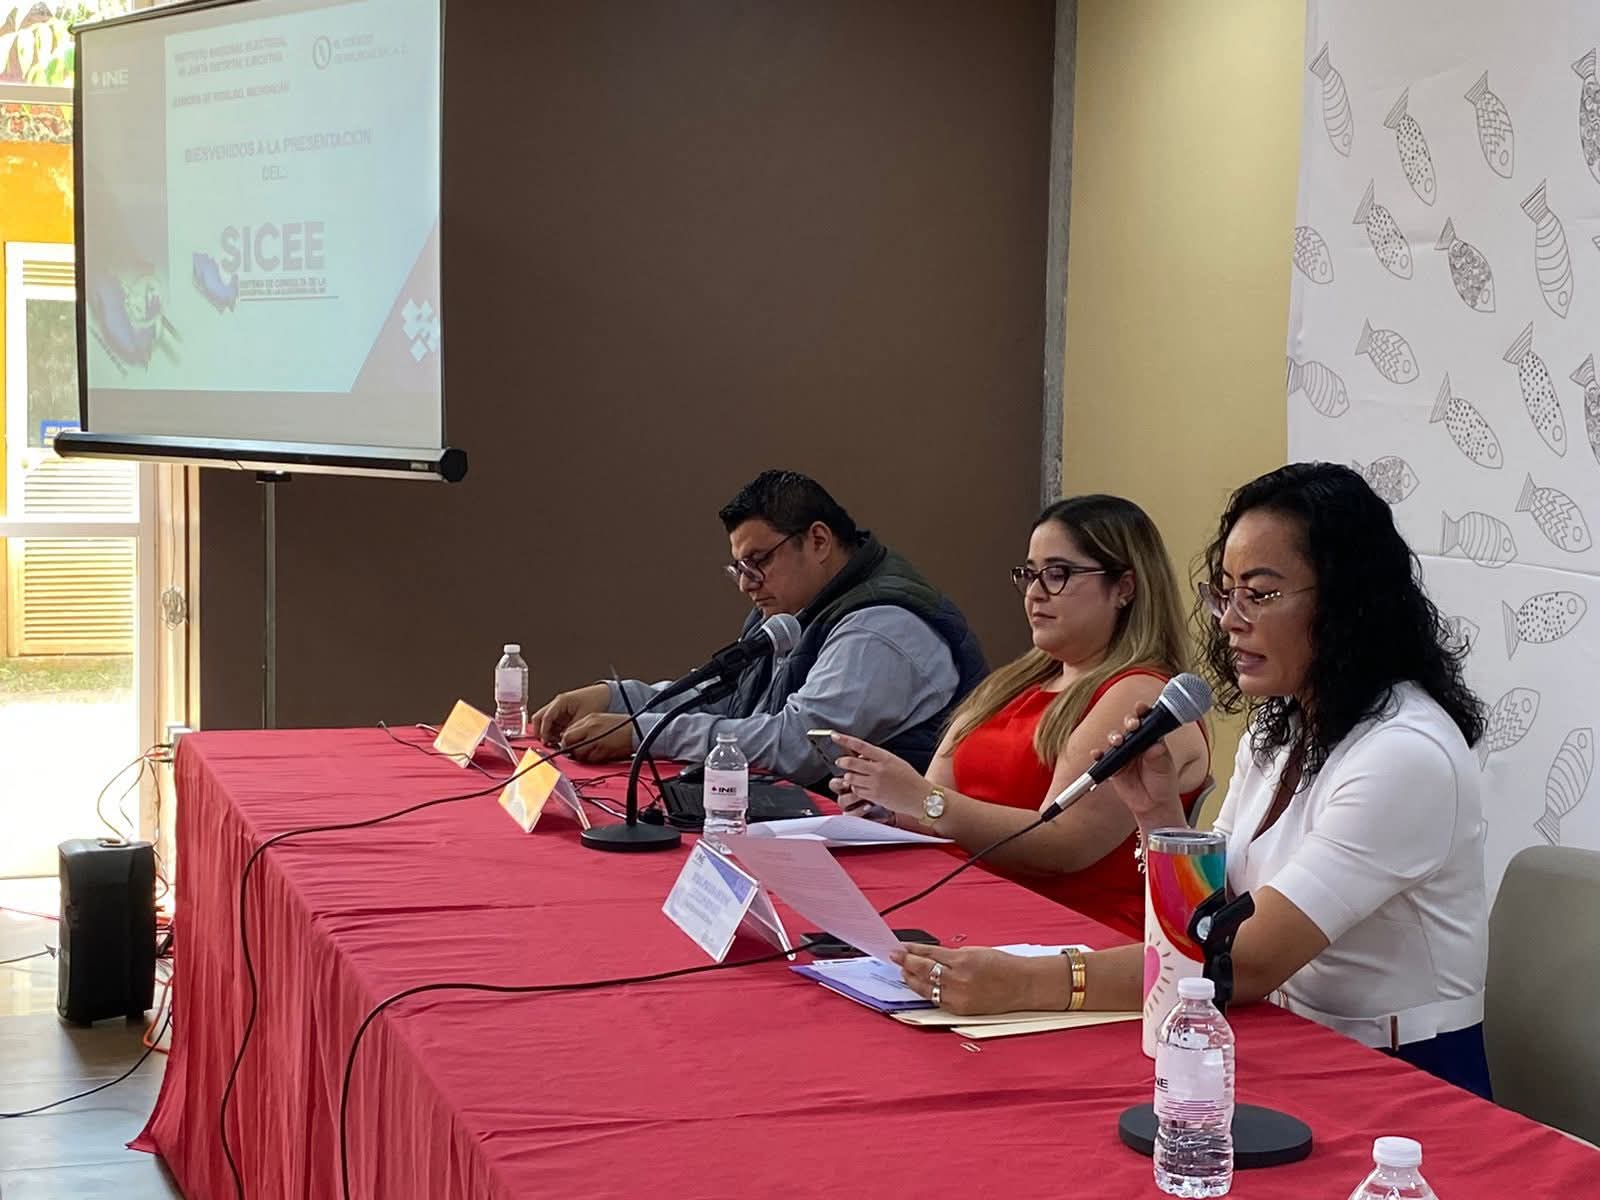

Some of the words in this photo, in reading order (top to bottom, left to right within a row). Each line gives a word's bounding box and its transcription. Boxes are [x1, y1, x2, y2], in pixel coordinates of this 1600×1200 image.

[185, 141, 256, 164] BIENVENIDOS
[257, 140, 265, 155] A
[267, 139, 281, 155] LA
[221, 221, 325, 273] SICEE
